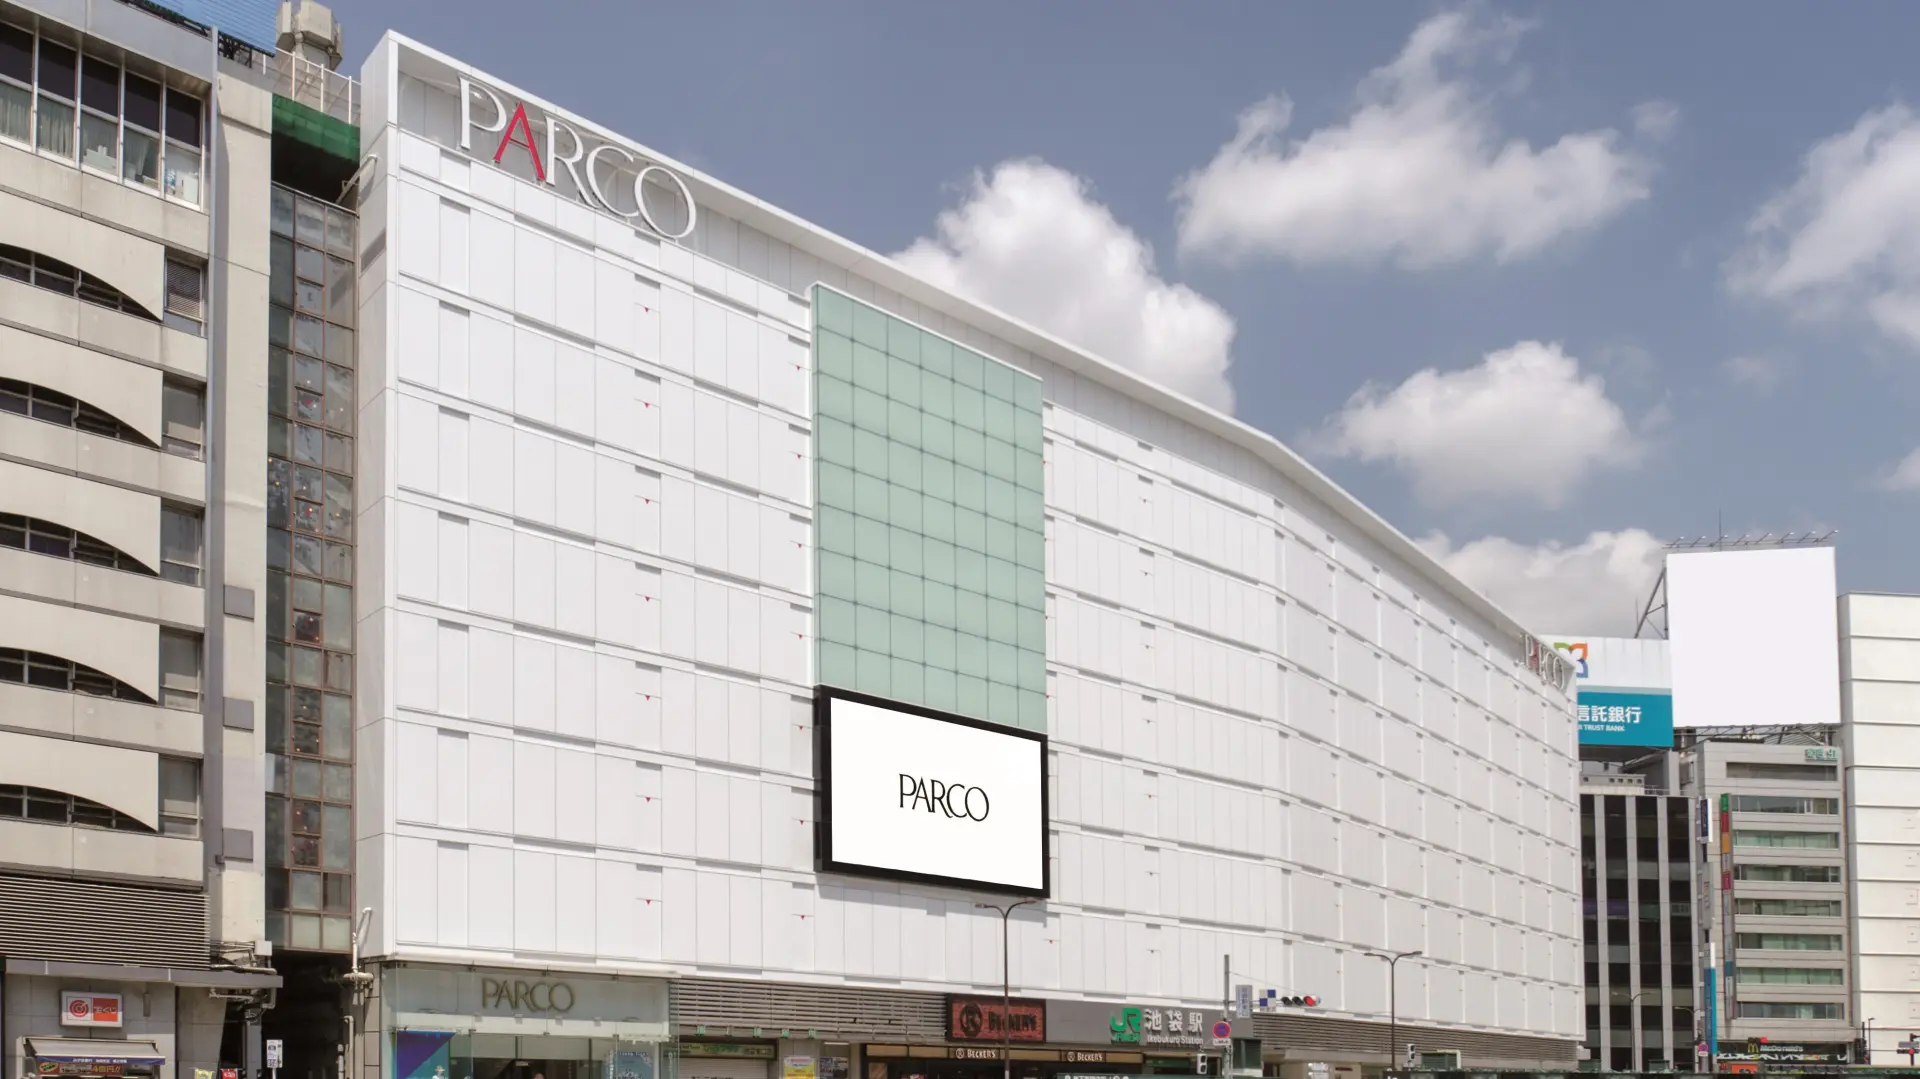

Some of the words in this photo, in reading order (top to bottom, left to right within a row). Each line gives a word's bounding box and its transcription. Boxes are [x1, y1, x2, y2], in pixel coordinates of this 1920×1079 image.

[458, 75, 697, 239] PARCO
[899, 773, 989, 822] PARCO
[481, 977, 575, 1013] PARCO
[1110, 1007, 1141, 1032] JR
[1143, 1008, 1203, 1033] 池袋駅
[1147, 1034, 1180, 1044] Ikebukuro
[1181, 1035, 1204, 1045] Station
[967, 1049, 997, 1059] BECKER'S
[1077, 1051, 1103, 1062] BECKER'S
